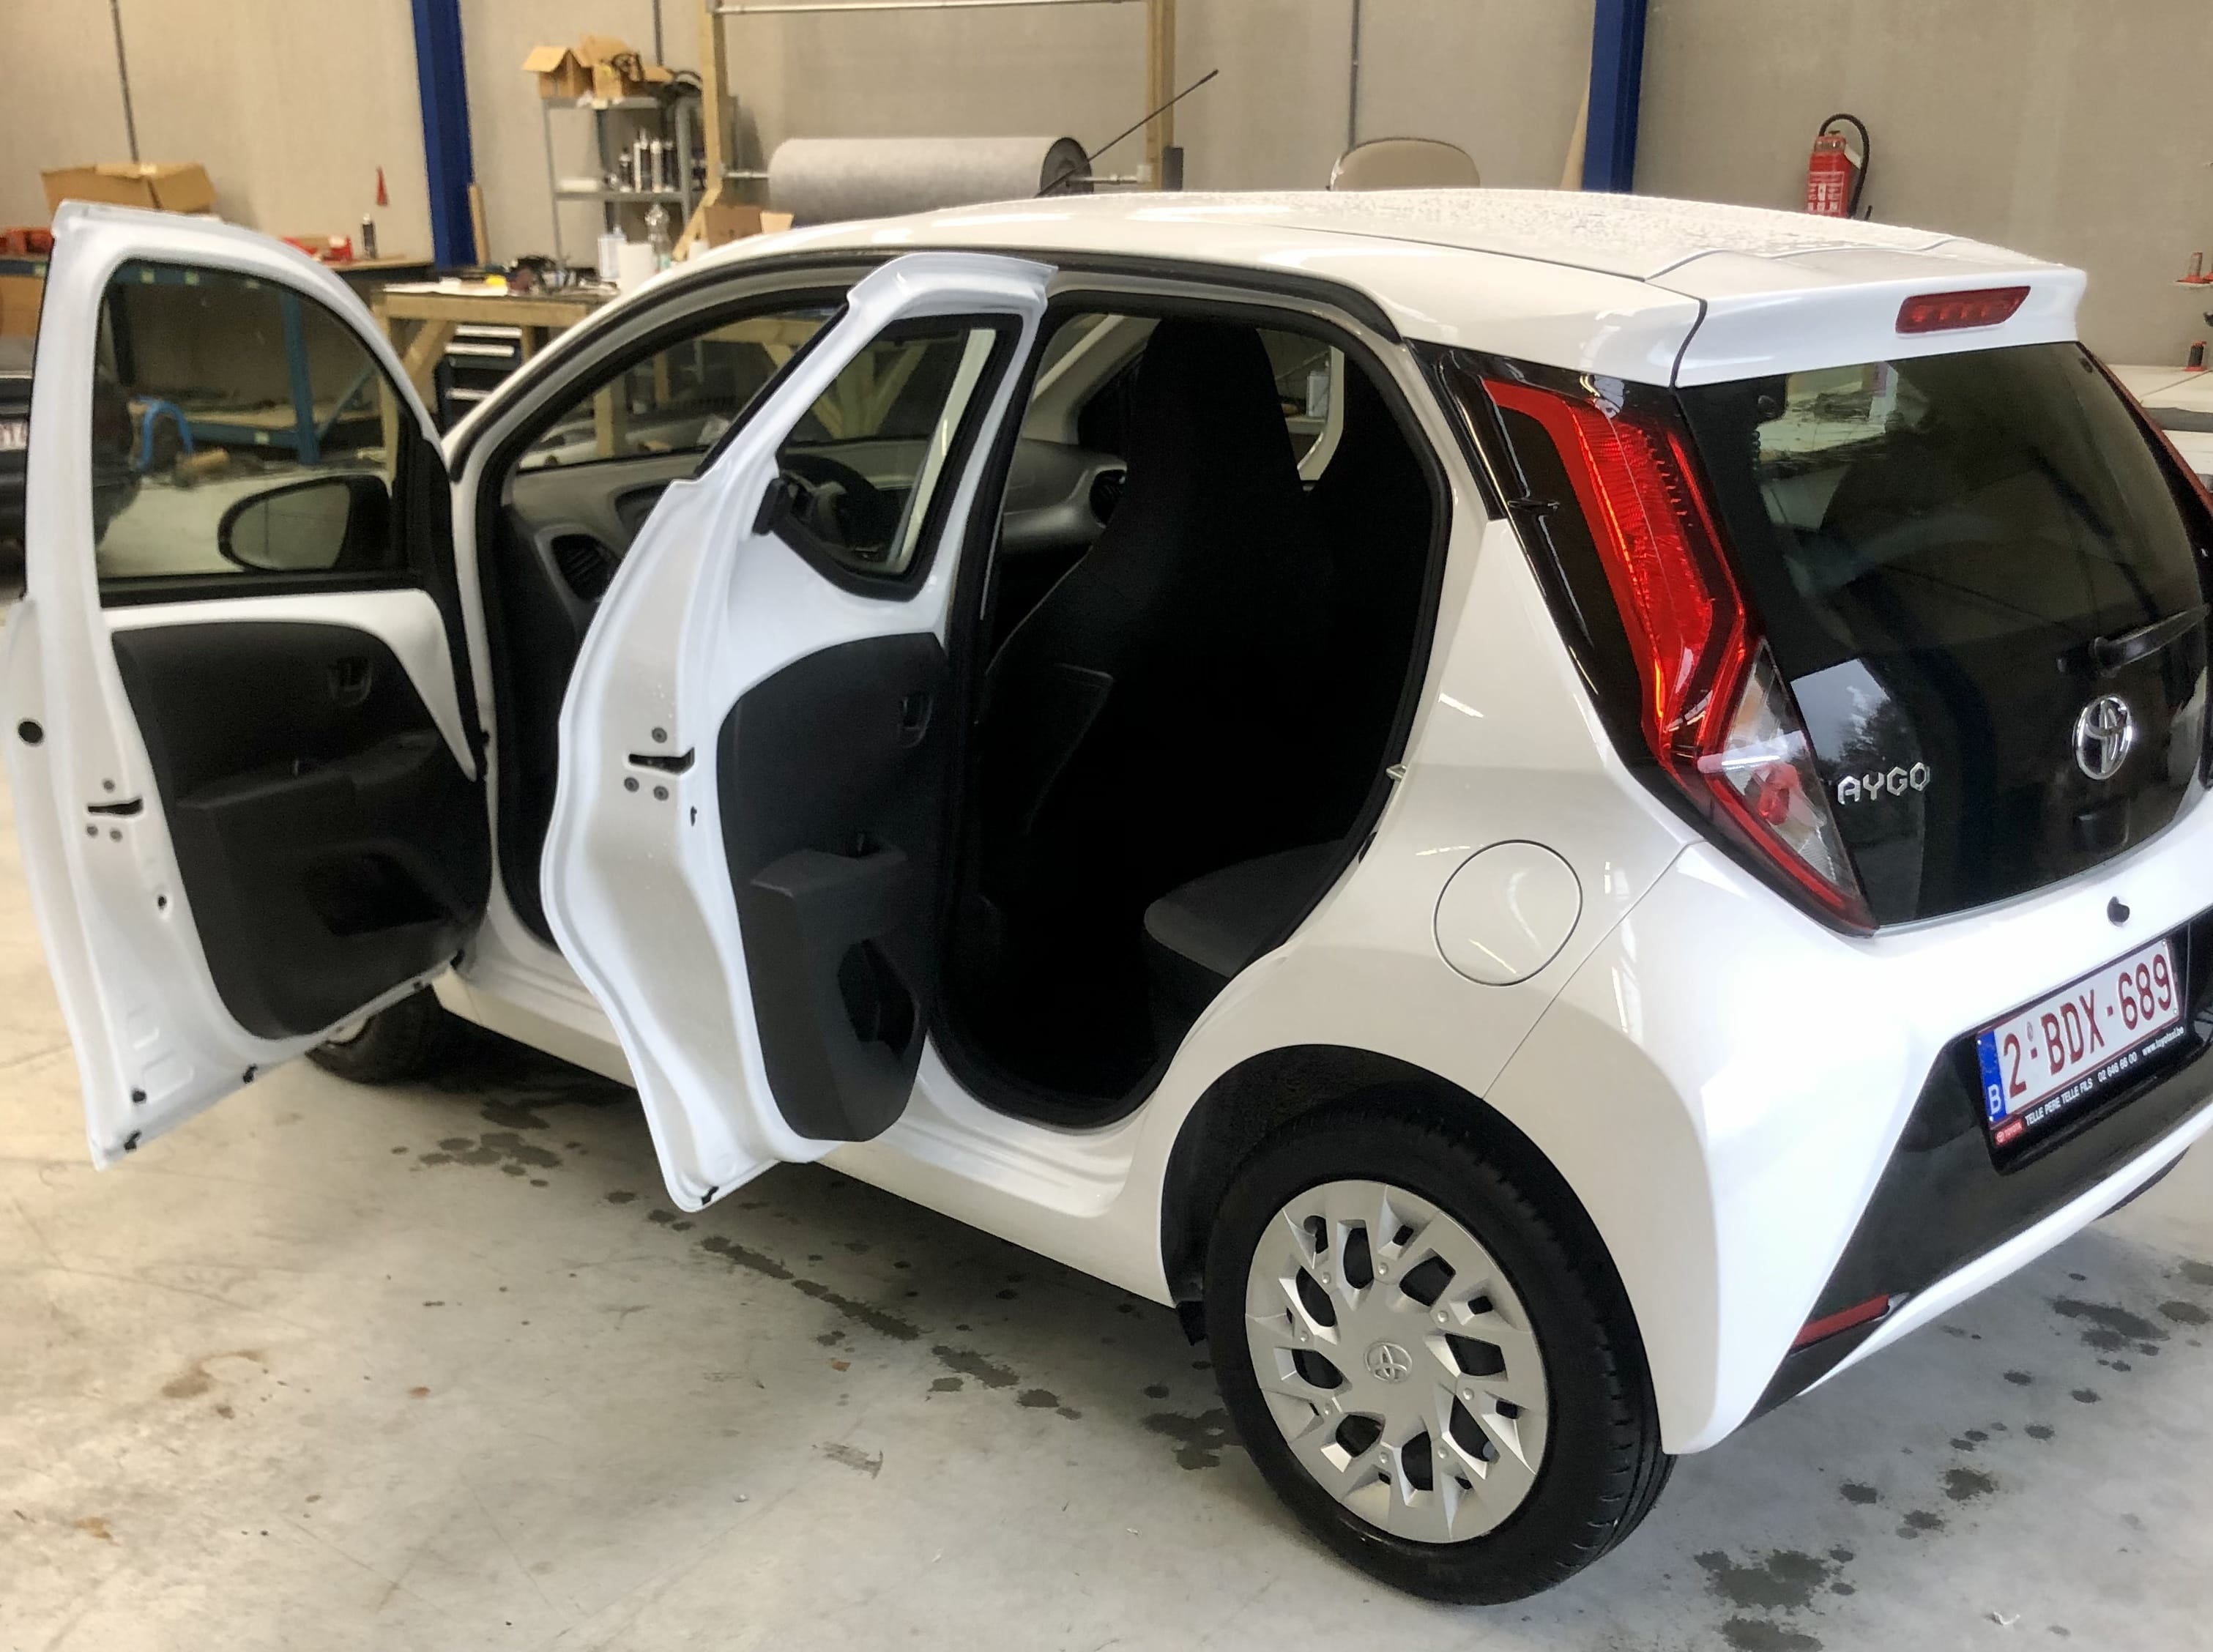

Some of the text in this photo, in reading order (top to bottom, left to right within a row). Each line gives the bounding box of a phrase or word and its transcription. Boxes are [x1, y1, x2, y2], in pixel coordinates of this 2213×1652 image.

[1837, 762, 1930, 805] AYGO
[1987, 1084, 2002, 1115] B
[2024, 1106, 2045, 1126] TELLE
[2061, 1086, 2080, 1104] TELLE
[2079, 1077, 2093, 1093] FILS
[2097, 1069, 2107, 1083] 02
